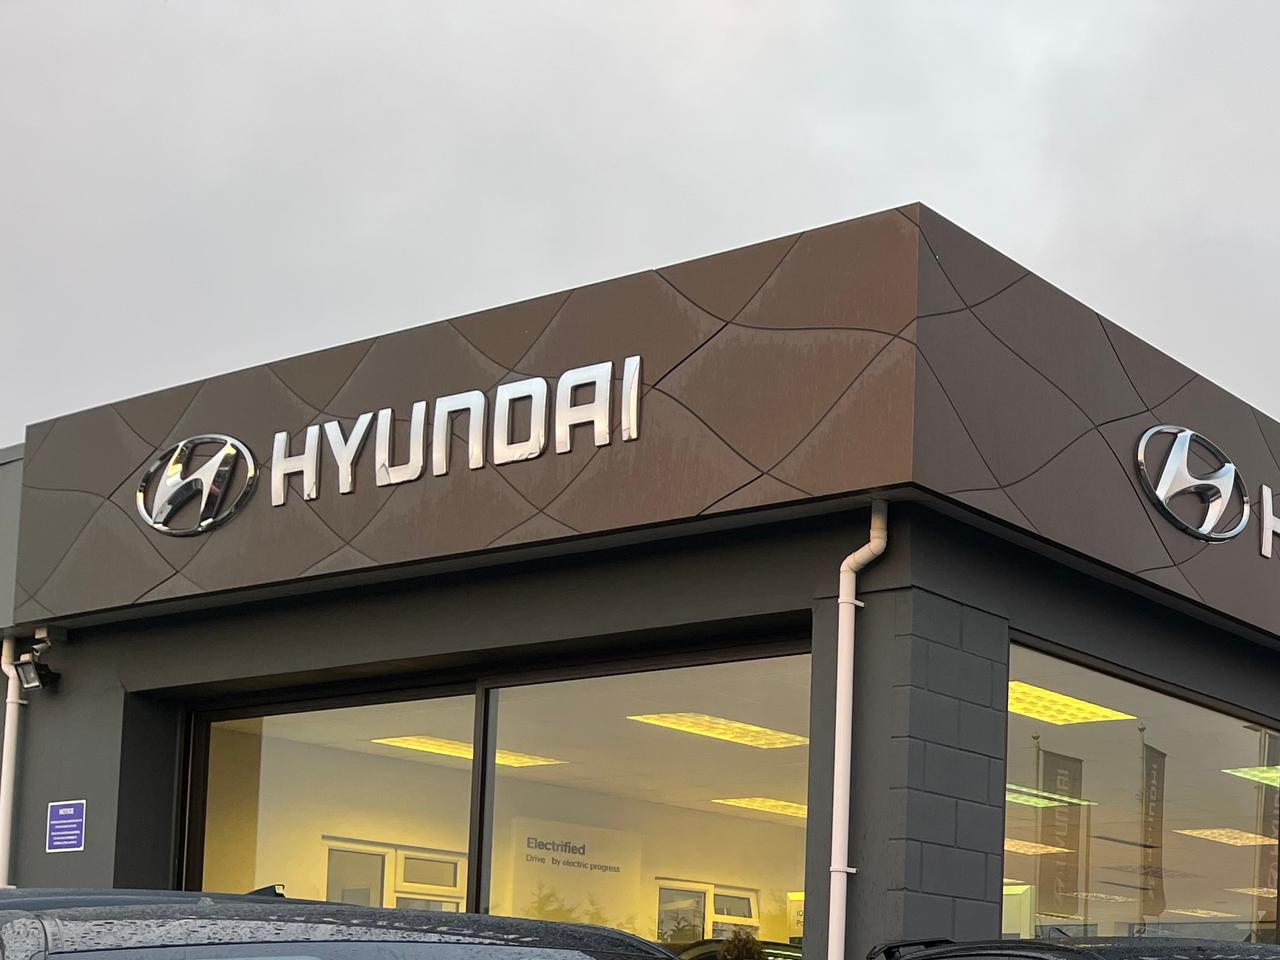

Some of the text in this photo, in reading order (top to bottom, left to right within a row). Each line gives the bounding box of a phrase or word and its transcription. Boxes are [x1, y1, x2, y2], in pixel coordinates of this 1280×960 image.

[271, 355, 642, 507] HYUNDAI
[526, 836, 586, 856] Electrified
[551, 856, 561, 867] by
[562, 859, 589, 870] electric
[589, 863, 620, 873] progress
